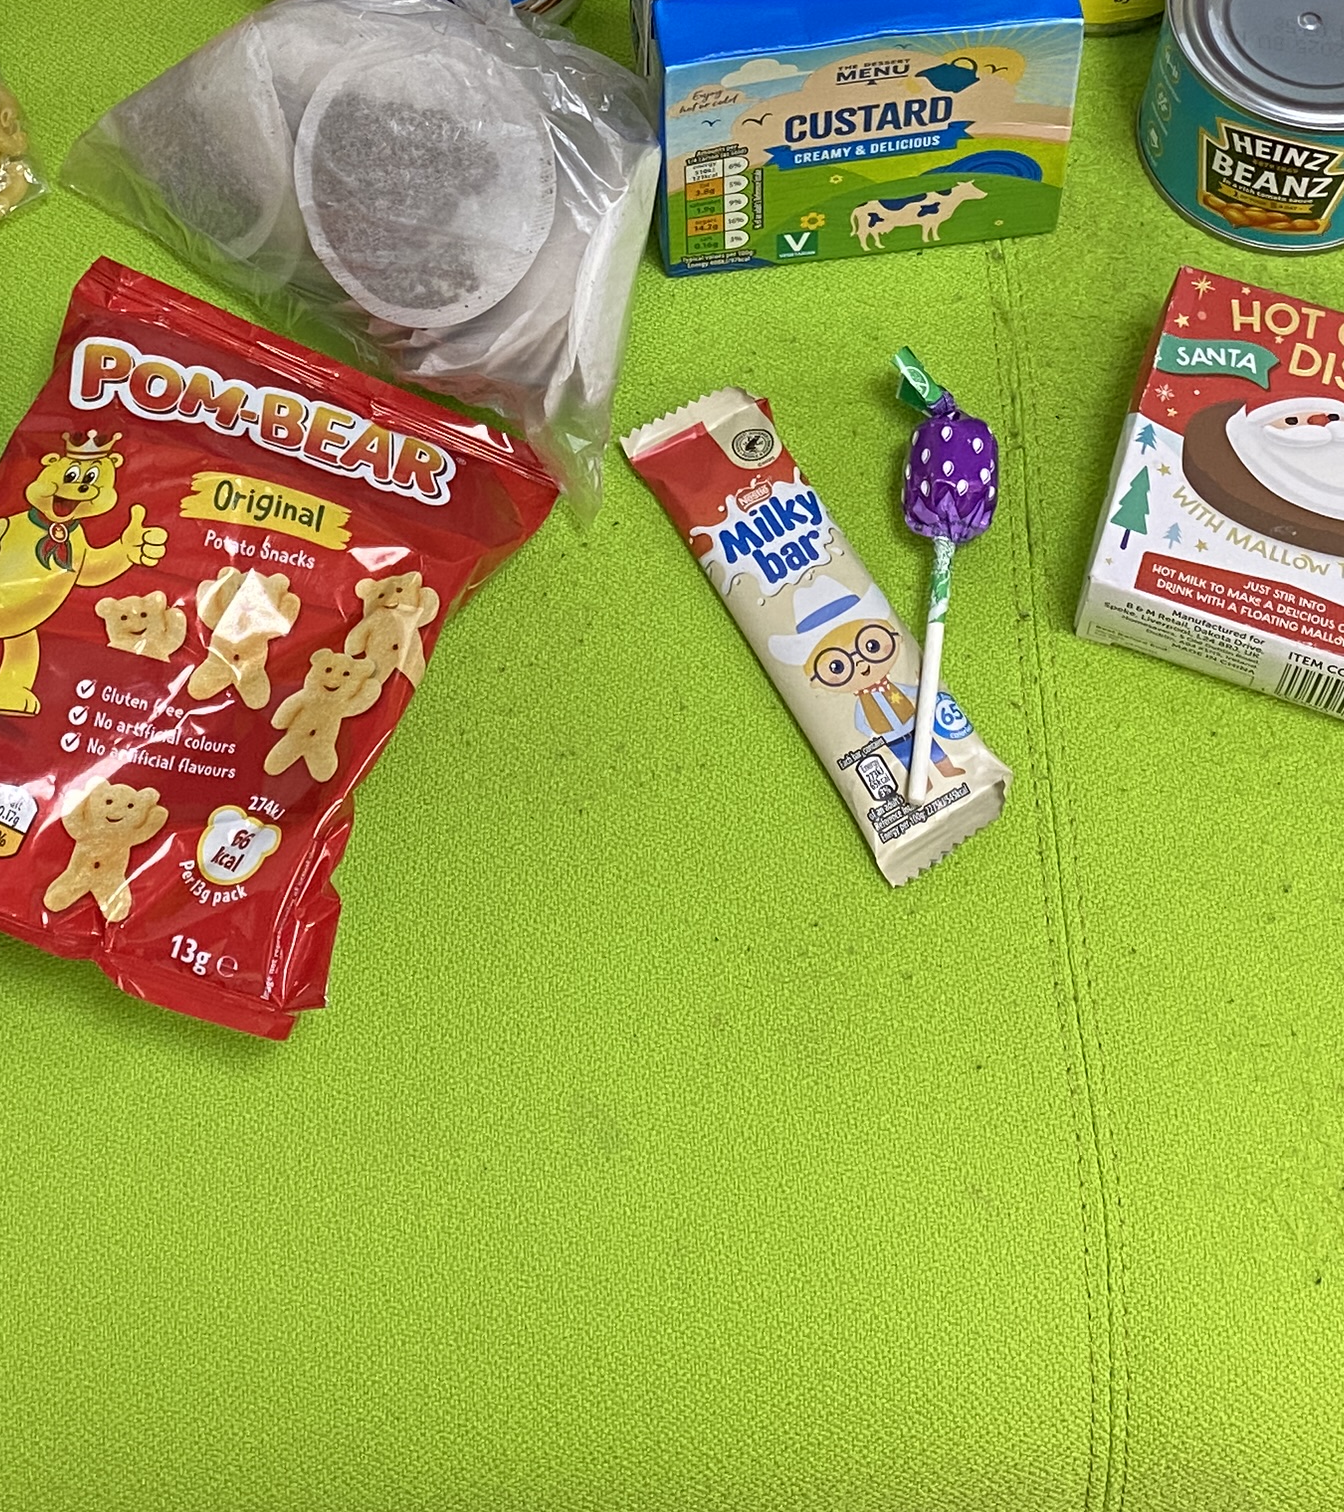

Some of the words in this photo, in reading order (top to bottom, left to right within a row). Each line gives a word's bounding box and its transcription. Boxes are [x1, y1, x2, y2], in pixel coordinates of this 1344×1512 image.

[836, 63, 911, 82] MENU
[863, 58, 912, 70] DESSERT
[784, 95, 954, 144] CUSTARD
[794, 144, 852, 165] CREAMY
[856, 143, 866, 156] &
[870, 135, 941, 154] DELICIOUS
[1231, 132, 1329, 172] HEINZ
[1211, 148, 1334, 198] BEANZ
[1231, 299, 1326, 340] HOT
[1176, 346, 1257, 374] SANTA
[80, 342, 447, 497] POM-BEAR
[213, 480, 324, 532] Original
[718, 490, 821, 565] Milky
[1172, 485, 1224, 534] WITH
[1225, 528, 1329, 577] MALLOW
[204, 529, 256, 558] Potato
[260, 535, 316, 569] Snacks
[752, 526, 819, 585] bar
[1152, 563, 1173, 579] HOT
[1174, 570, 1208, 587] MILK
[1210, 582, 1226, 594] TO
[1226, 587, 1262, 605] MAKE
[1276, 603, 1336, 630] DELICIOUS
[1157, 578, 1194, 598] DRINK
[1196, 592, 1225, 608] WITH
[1240, 606, 1299, 633] FLOATING
[1243, 580, 1271, 595] JUST
[1273, 589, 1297, 603] STIR
[1298, 597, 1327, 613] INTO
[1288, 652, 1323, 670] ITEM
[101, 686, 149, 713] Gluten
[940, 702, 963, 725] 65
[87, 739, 107, 757] No
[177, 762, 236, 779] flavours
[183, 735, 236, 756] colours
[247, 795, 287, 822] 274kJ
[210, 846, 243, 874] kcal
[169, 934, 211, 976] 13g
